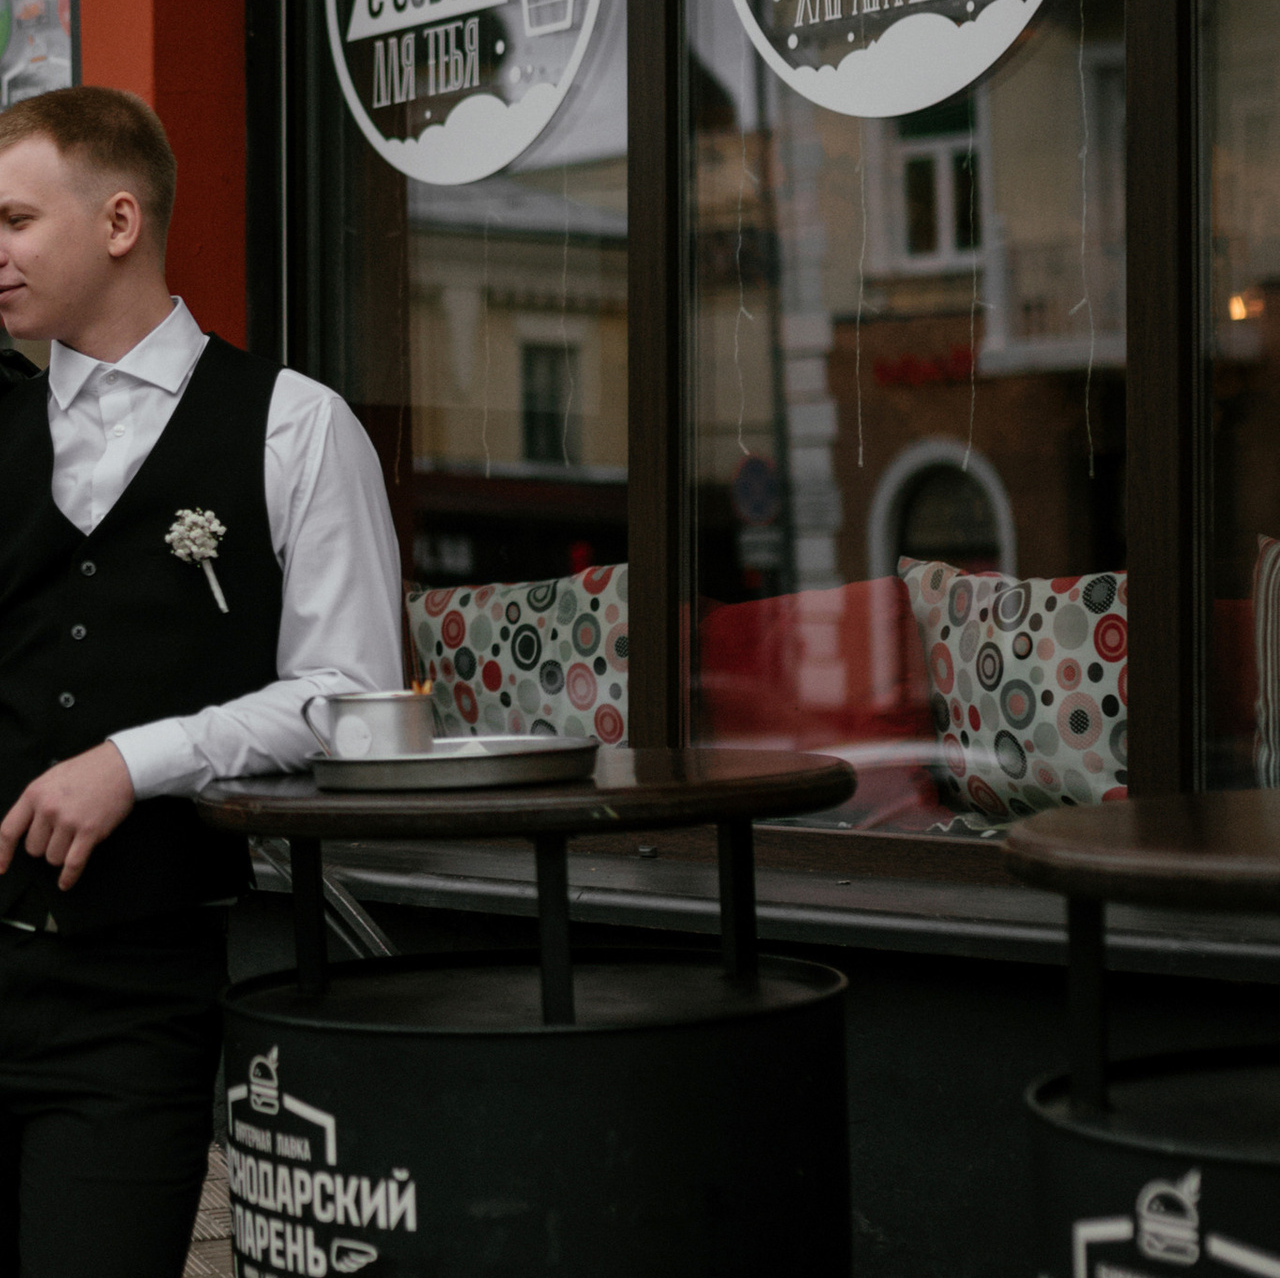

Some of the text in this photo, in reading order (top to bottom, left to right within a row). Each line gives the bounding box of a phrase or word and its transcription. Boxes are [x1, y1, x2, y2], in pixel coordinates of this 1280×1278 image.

[423, 16, 481, 97] ТЕБЯ
[275, 1132, 312, 1162] ЛАВКА
[227, 1143, 418, 1232] СНОДАРСКИЙ
[234, 1203, 329, 1278] ПАРЕНЬ
